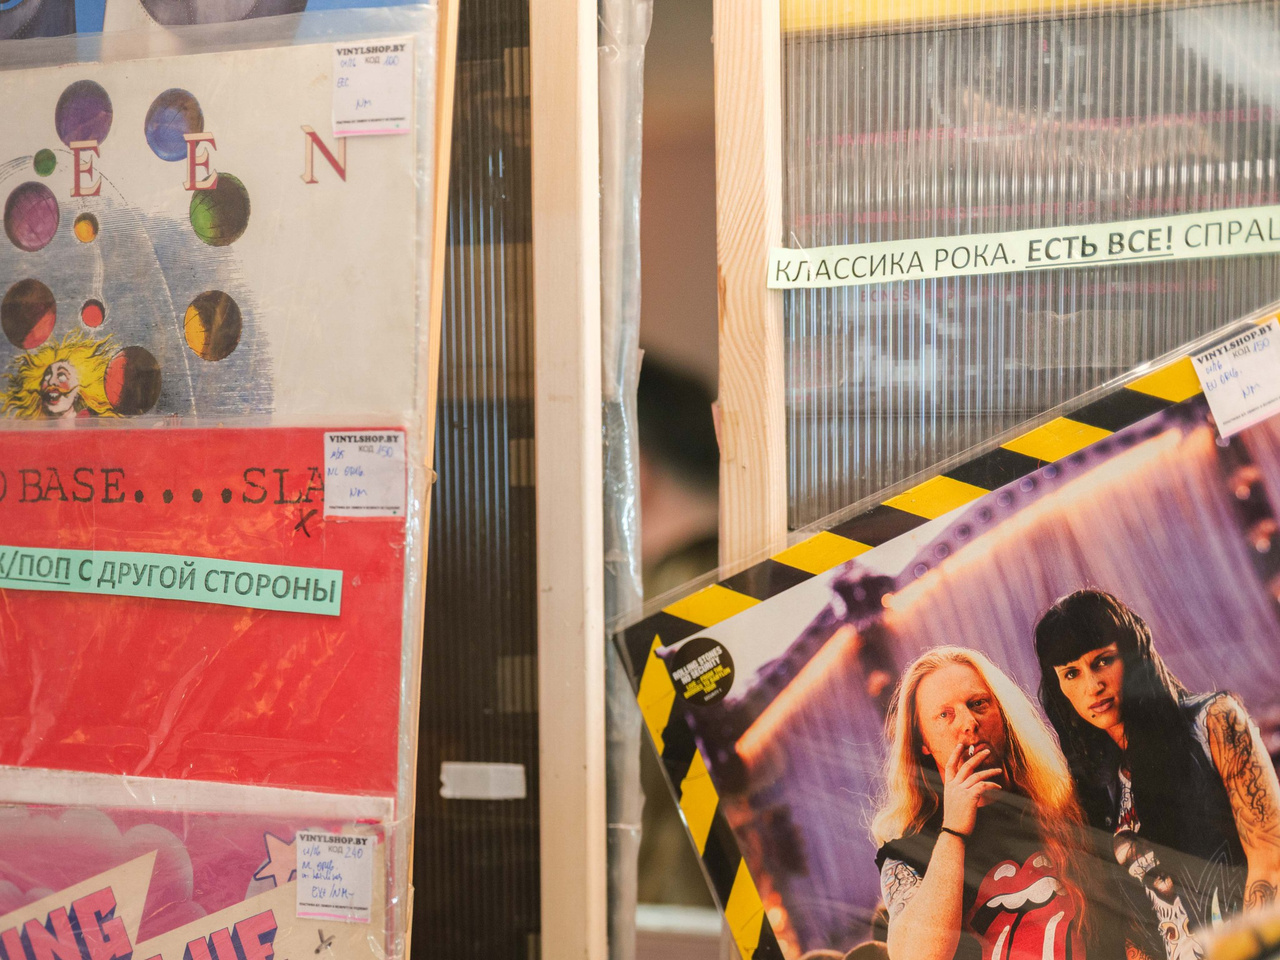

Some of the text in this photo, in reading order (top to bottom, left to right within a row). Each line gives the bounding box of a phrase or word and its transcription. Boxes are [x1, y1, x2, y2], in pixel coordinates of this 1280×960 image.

[336, 43, 406, 56] VINYLSHOP.BY
[365, 55, 380, 64] КОД
[775, 250, 924, 283] КЛАССИКА
[934, 242, 1017, 272] РОКА.
[1028, 234, 1098, 263] ЕСТЬ
[1108, 225, 1173, 257] ВСЕ!
[1196, 322, 1274, 365] VINYLSHOP.BY
[1233, 345, 1251, 359] КОД
[329, 435, 399, 444] VINYLSHOP.BY
[358, 445, 374, 453] КОД
[78, 558, 94, 582] С
[97, 560, 197, 591] ДРУГОЙ
[204, 568, 337, 604] СТОРОНЫ
[299, 834, 368, 846] VINYLSHOP.BY
[328, 845, 343, 854] КОД
